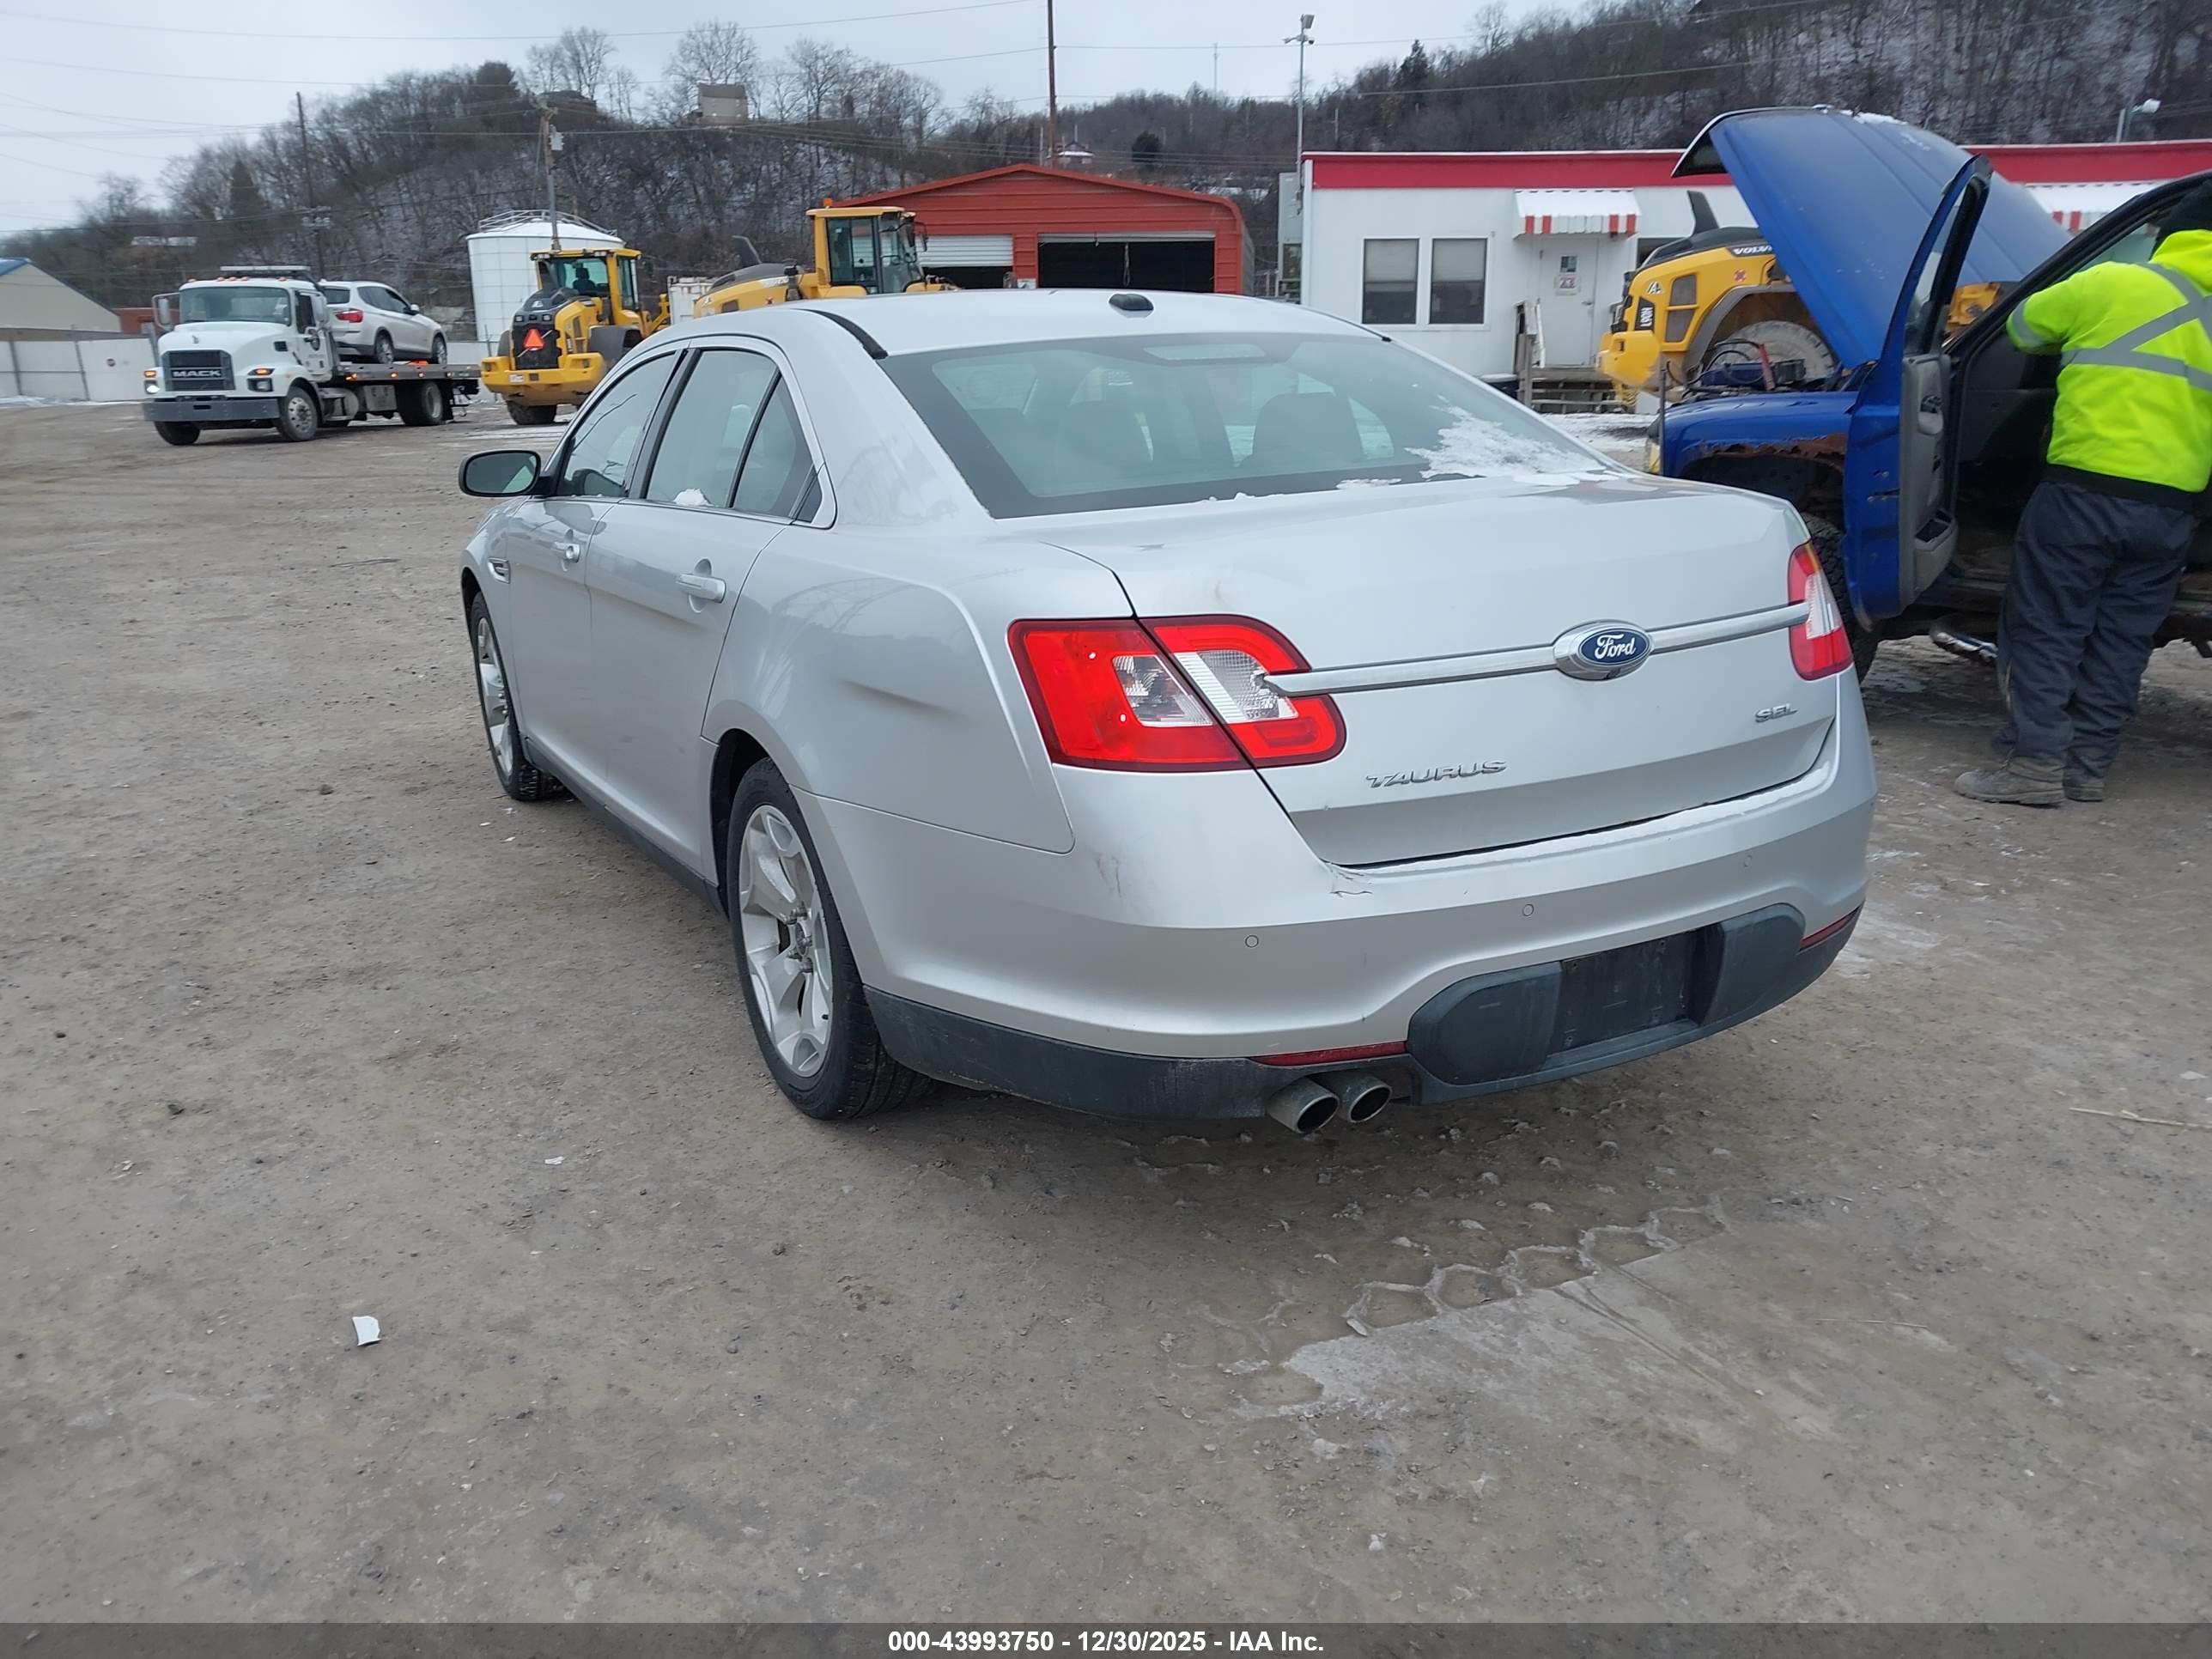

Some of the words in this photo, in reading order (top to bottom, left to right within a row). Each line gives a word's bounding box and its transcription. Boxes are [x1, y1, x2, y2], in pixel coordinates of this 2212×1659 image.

[1595, 634, 1637, 659] Ford
[1754, 703, 1799, 723] SEL
[1365, 761, 1507, 788] TAURUS
